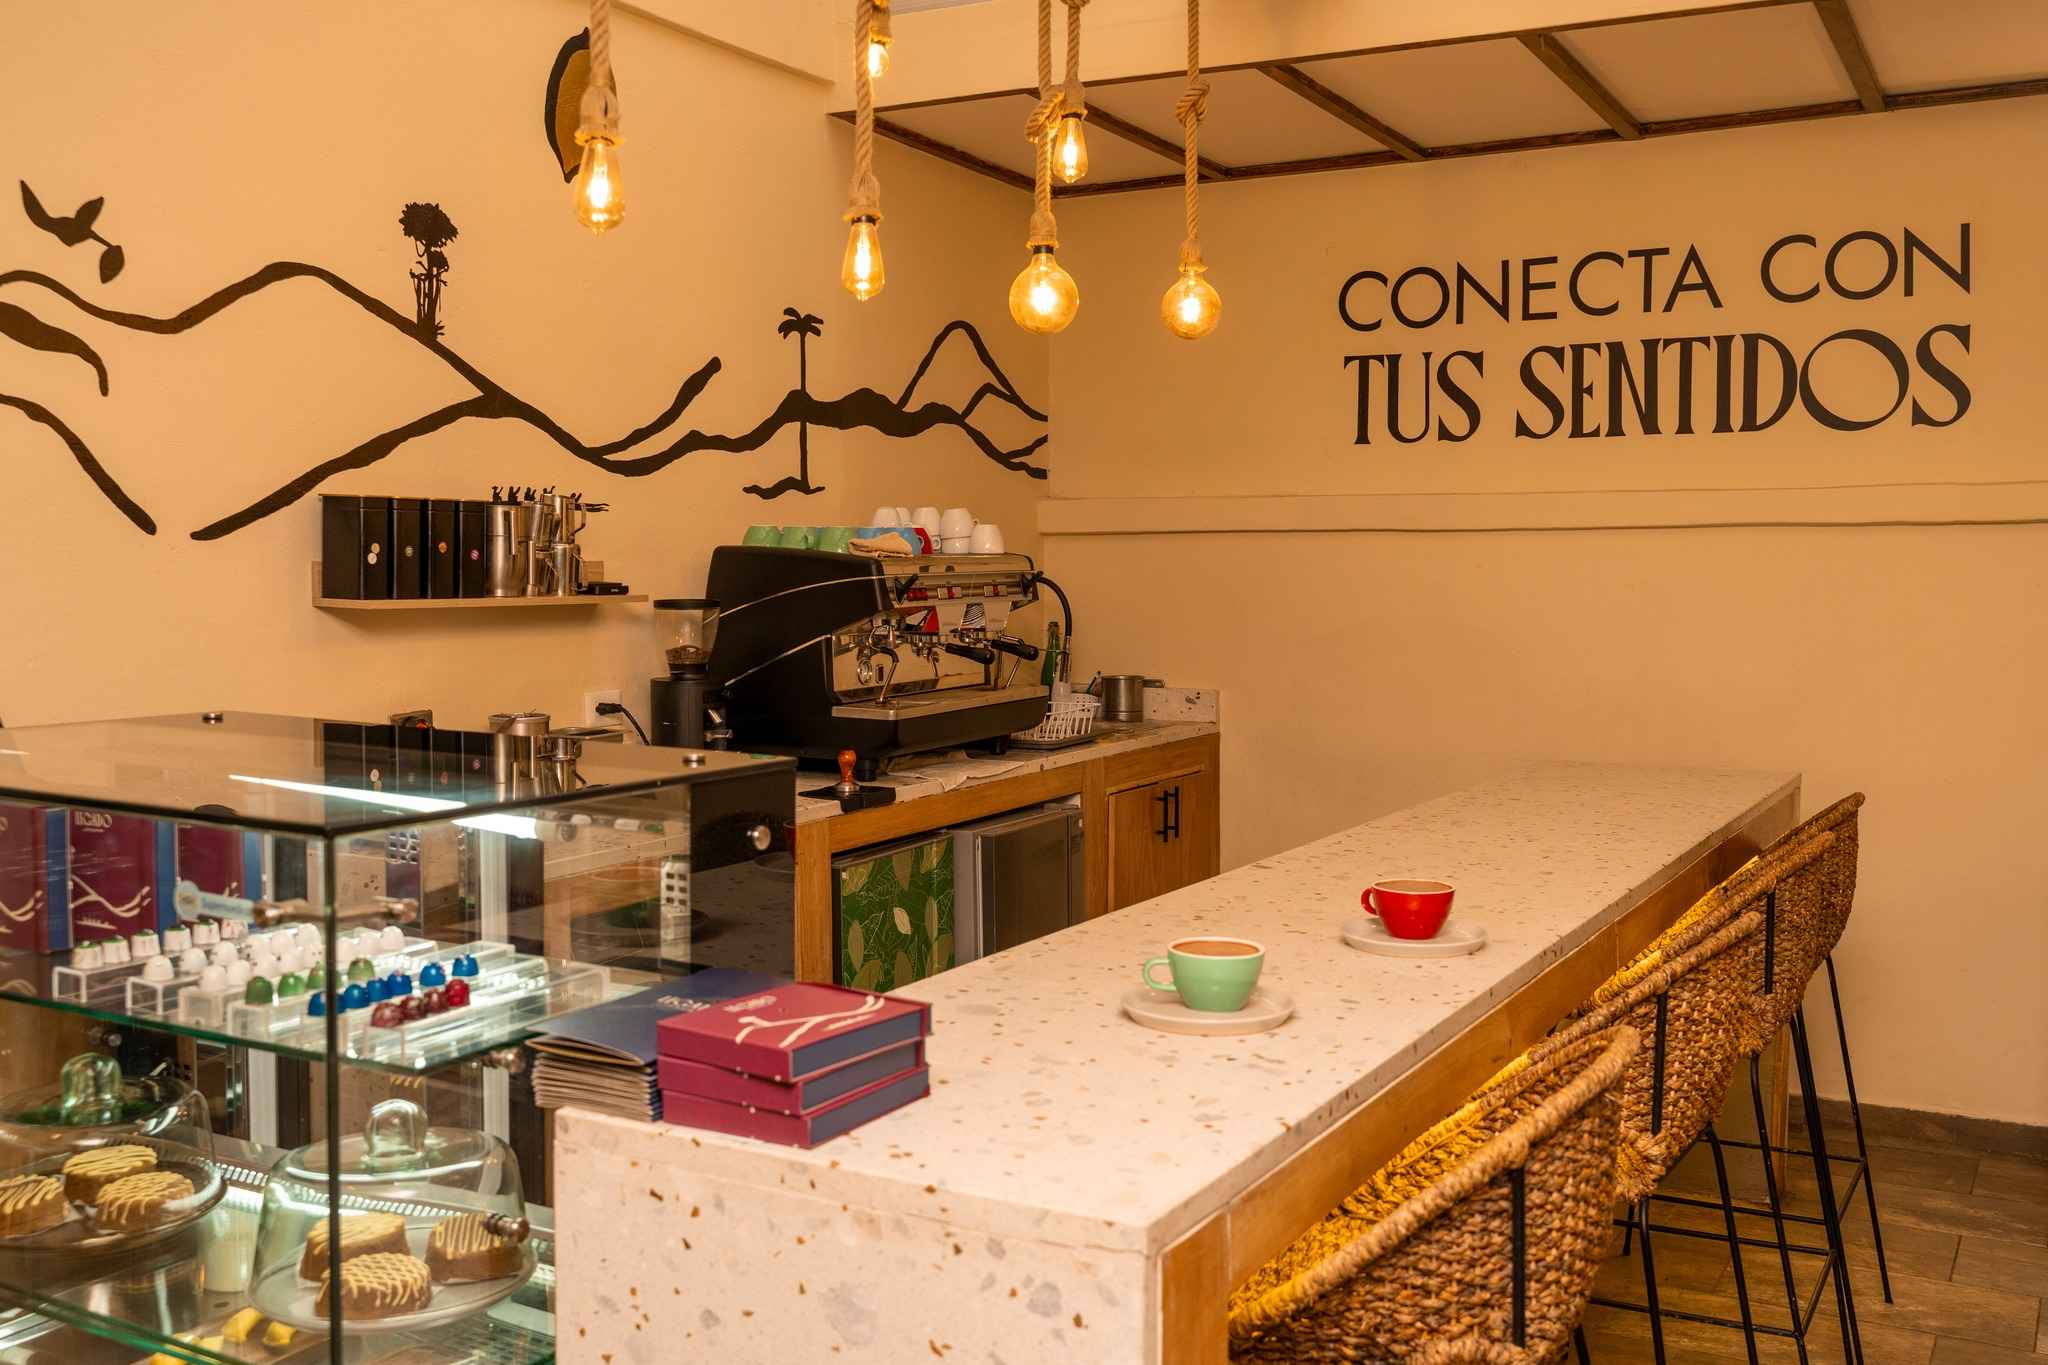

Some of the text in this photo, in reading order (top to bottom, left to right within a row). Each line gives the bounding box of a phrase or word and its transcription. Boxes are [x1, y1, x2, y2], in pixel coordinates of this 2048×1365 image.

[1338, 222, 1971, 333] CONECTA CON
[1343, 323, 1972, 445] TUS SENTIDOS
